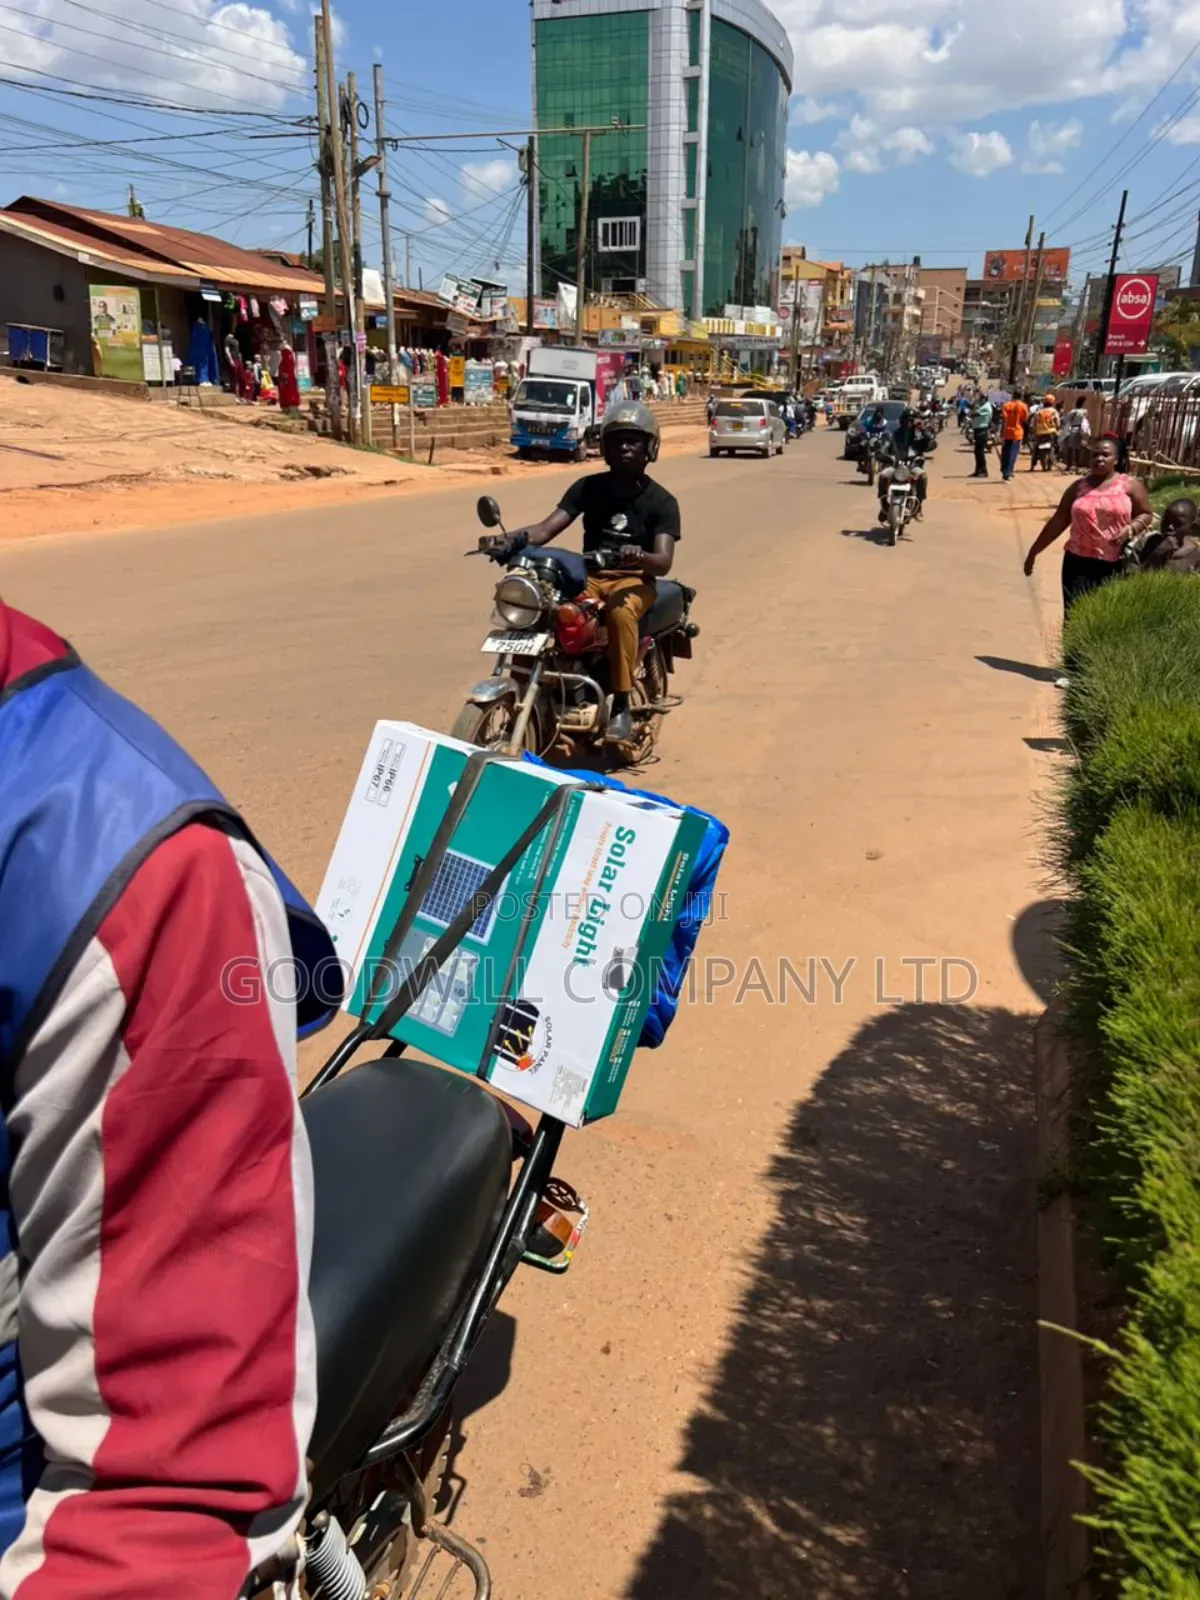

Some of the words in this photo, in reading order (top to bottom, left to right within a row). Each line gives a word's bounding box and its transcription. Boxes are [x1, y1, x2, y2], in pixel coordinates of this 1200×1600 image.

[1121, 290, 1147, 304] absa
[372, 764, 385, 788] IP67
[382, 768, 397, 792] IP66
[598, 825, 636, 893] Solar
[572, 898, 610, 967] Light
